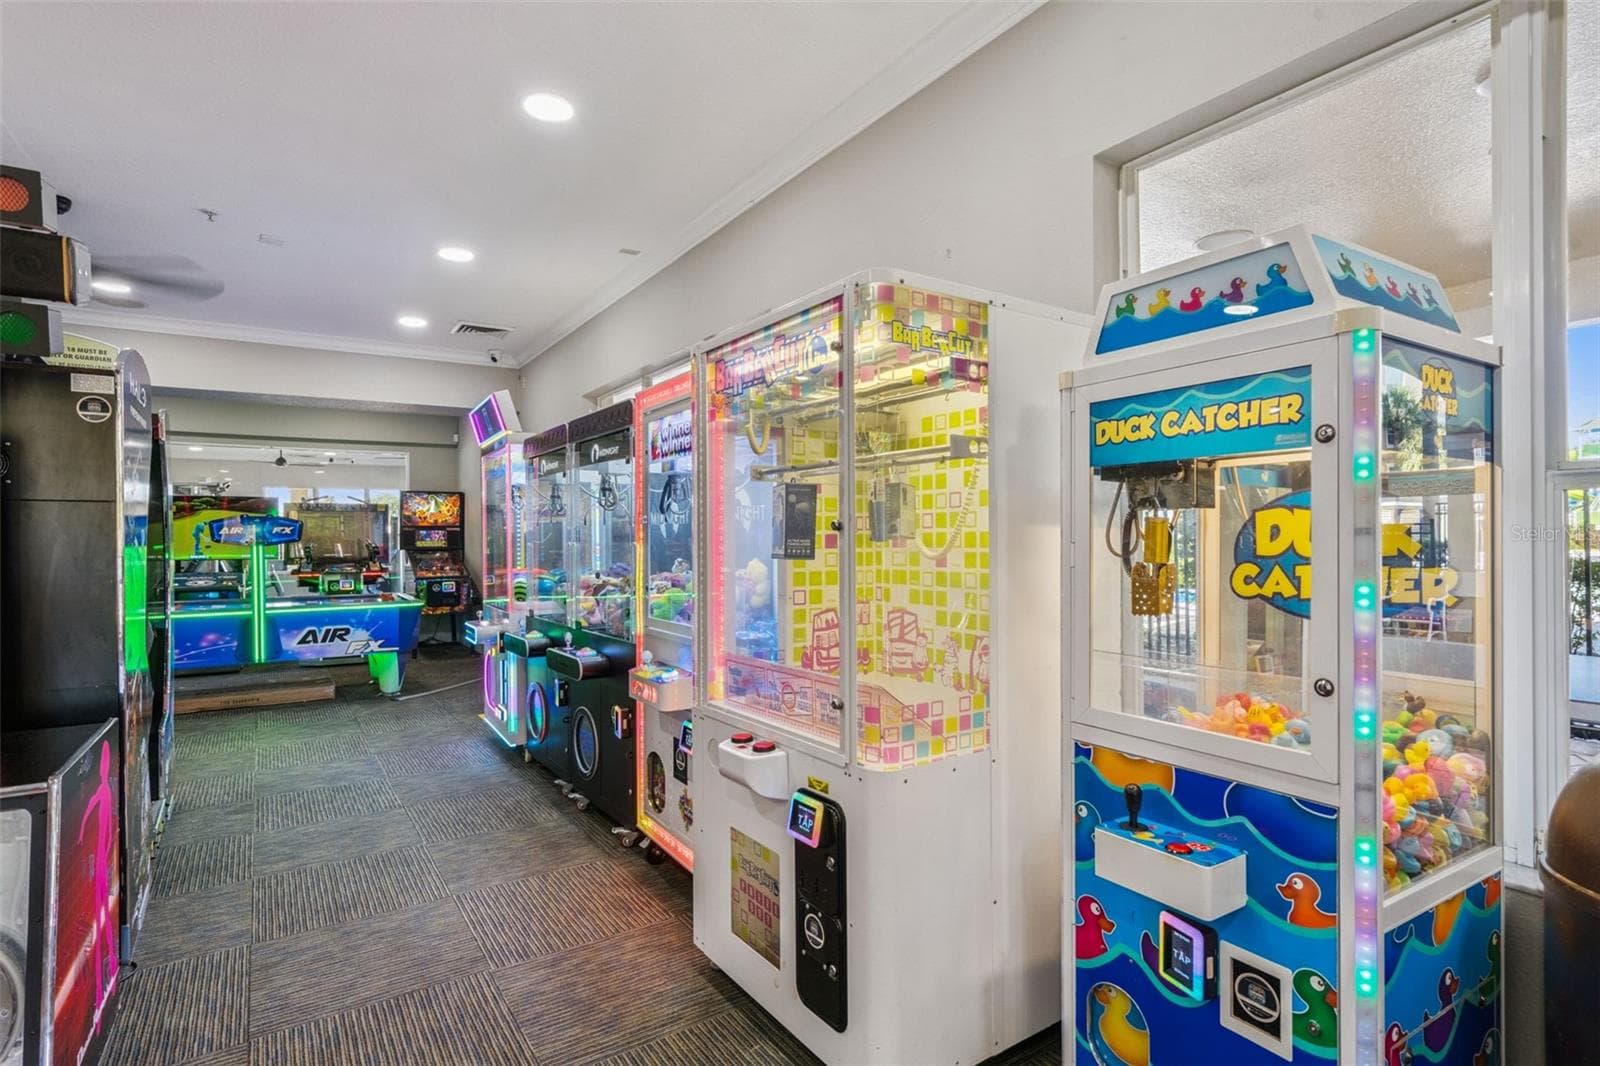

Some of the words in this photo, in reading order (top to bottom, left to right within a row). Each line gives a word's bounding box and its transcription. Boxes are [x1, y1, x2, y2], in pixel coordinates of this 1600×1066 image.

[74, 354, 112, 362] GUARDIAN
[1422, 364, 1454, 394] DUCK
[1095, 413, 1157, 446] DUCK
[1160, 393, 1304, 437] CATCHER
[219, 526, 243, 535] AIR
[272, 526, 294, 534] FX
[296, 627, 351, 645] AIR
[345, 640, 396, 655] FX
[798, 814, 814, 828] TAP
[1172, 948, 1191, 965] TAP
